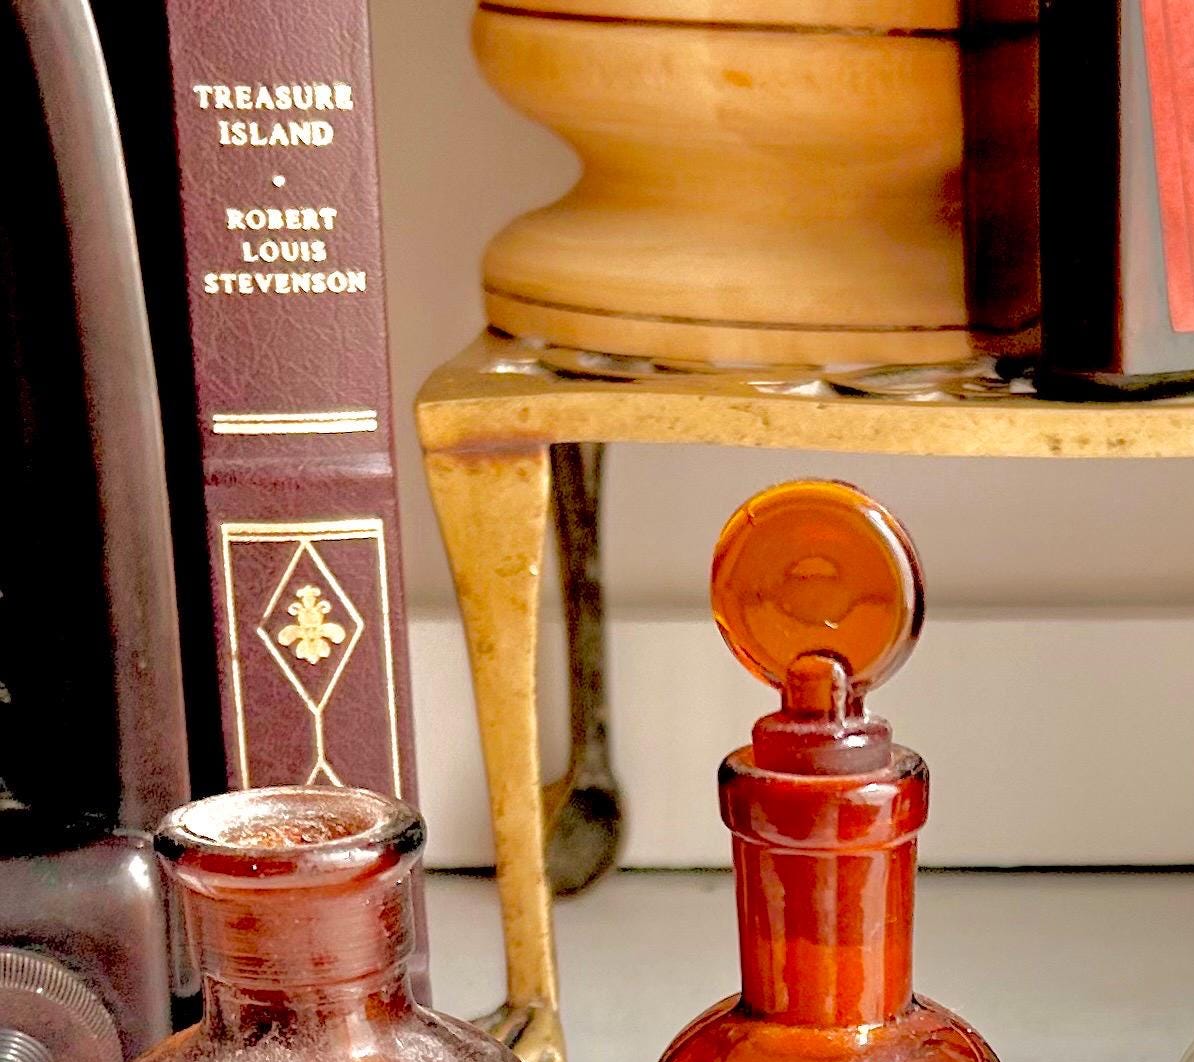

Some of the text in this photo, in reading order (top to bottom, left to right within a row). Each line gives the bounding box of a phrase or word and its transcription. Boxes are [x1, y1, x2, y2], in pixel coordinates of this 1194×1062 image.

[193, 82, 353, 110] TREASURE
[217, 120, 334, 147] ISLAND
[226, 206, 338, 230] ROBERT
[240, 239, 327, 262] LOUIS
[203, 271, 367, 294] STEVENSON
